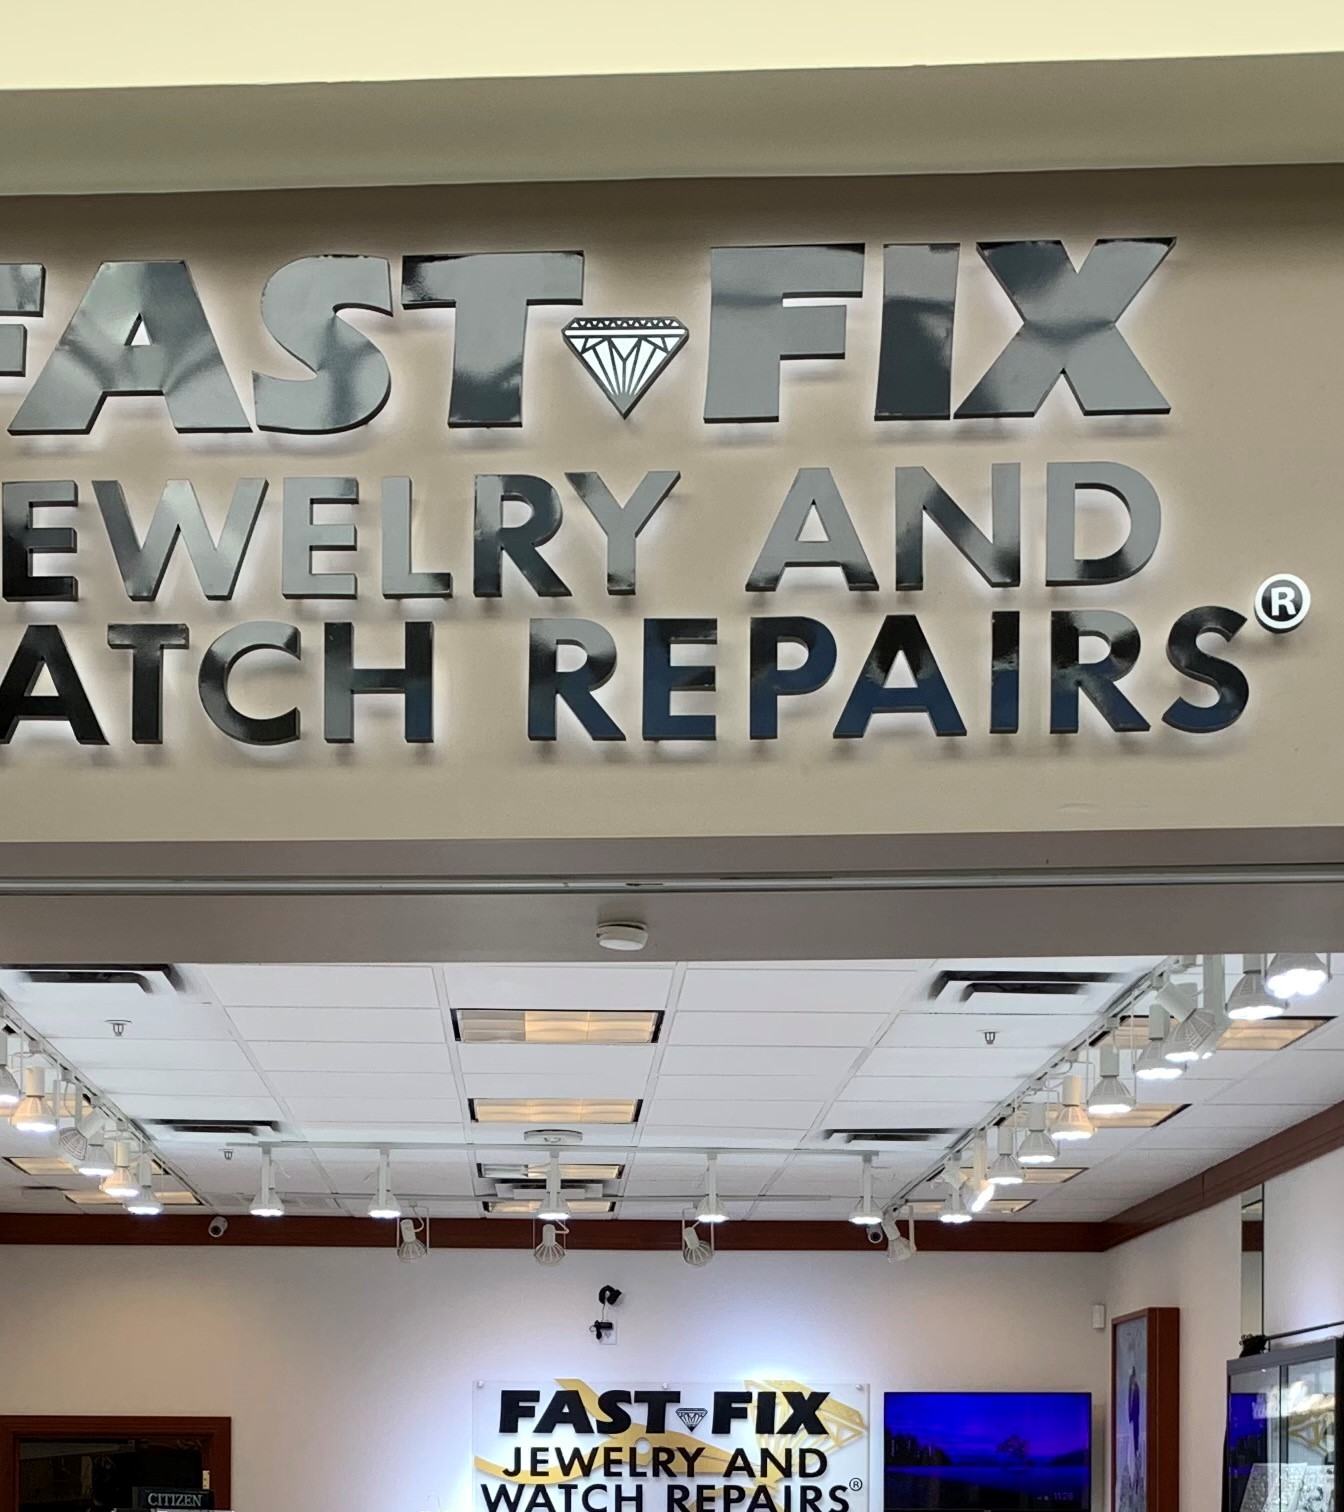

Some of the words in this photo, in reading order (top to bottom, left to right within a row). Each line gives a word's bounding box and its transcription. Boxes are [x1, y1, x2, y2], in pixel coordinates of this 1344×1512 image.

[703, 235, 1178, 424] FIX
[744, 460, 1163, 592] AND
[526, 605, 1252, 742] REPAIRS
[499, 1389, 681, 1435] FAST
[711, 1391, 830, 1436] FIX
[147, 1493, 202, 1507] CITIZEN
[502, 1446, 706, 1478] JEWELRY
[722, 1447, 828, 1479] AND
